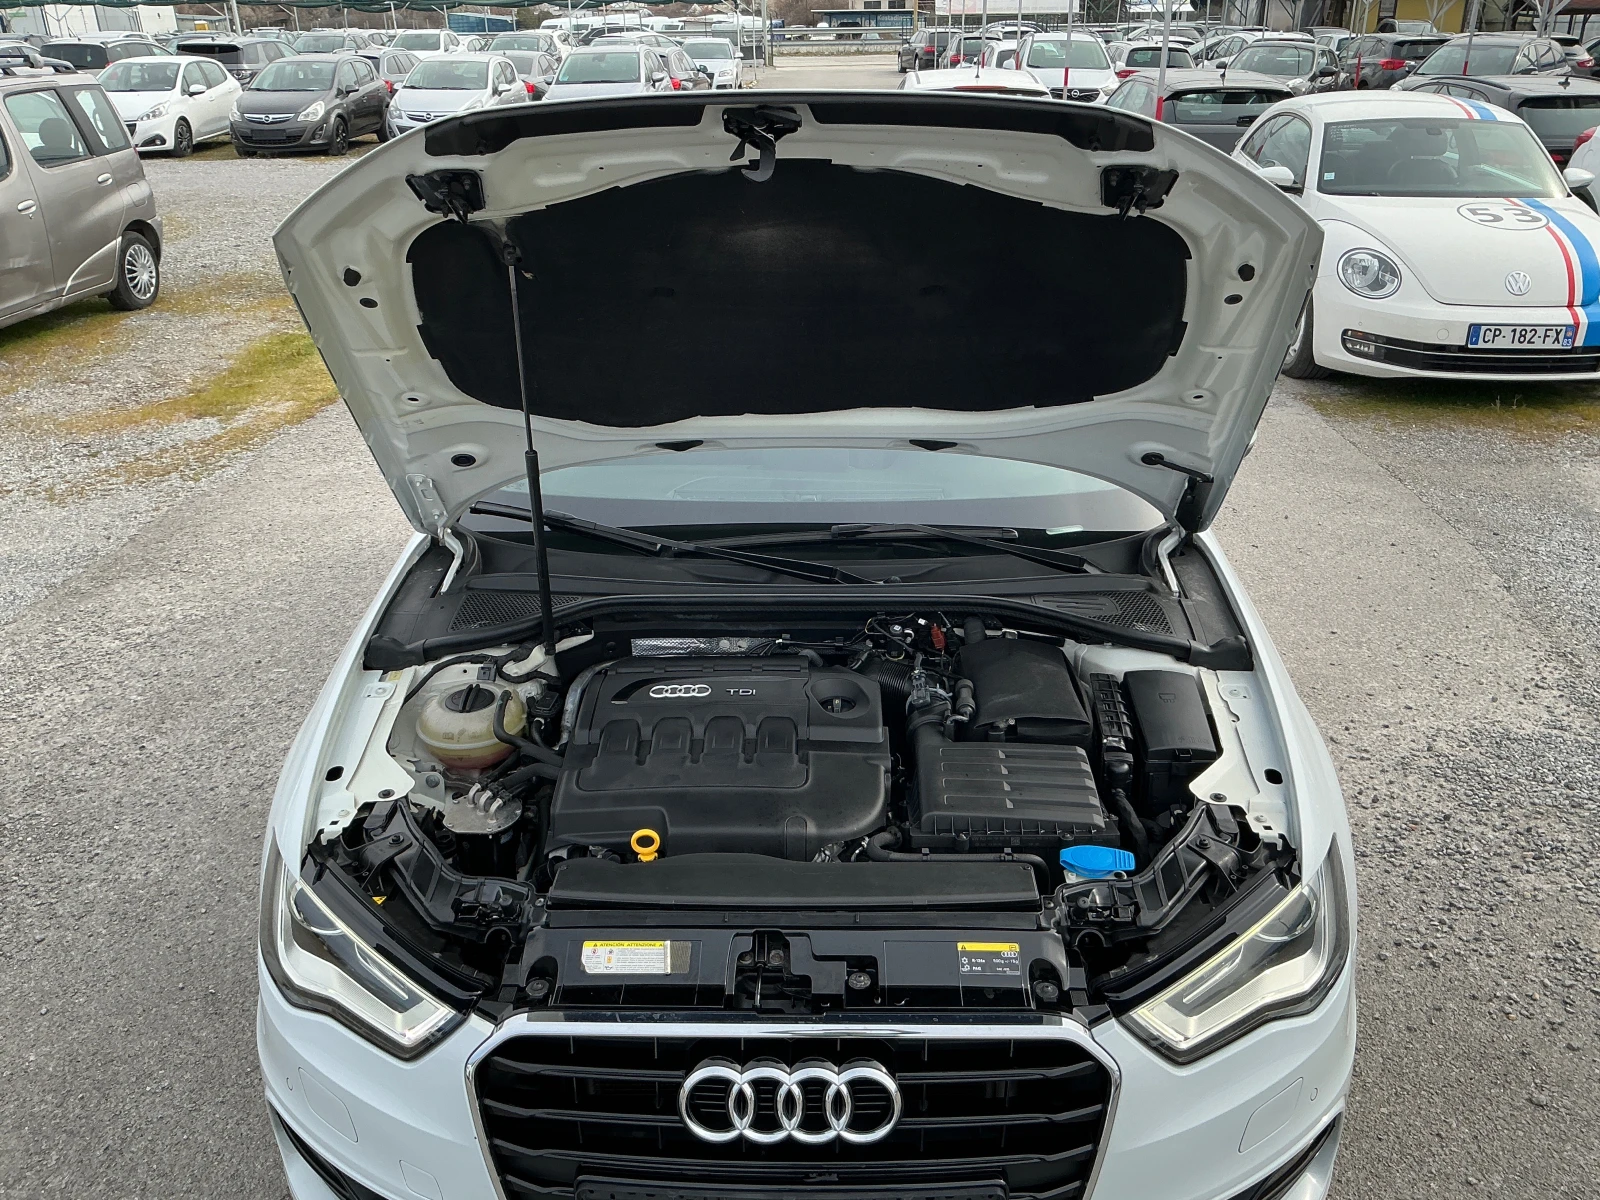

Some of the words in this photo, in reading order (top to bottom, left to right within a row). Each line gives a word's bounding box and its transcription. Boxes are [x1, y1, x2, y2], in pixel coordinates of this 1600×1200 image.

[1466, 207, 1543, 223] 53
[1482, 327, 1563, 345] CP-182-FX
[1562, 338, 1572, 346] 83
[726, 688, 756, 696] TDI
